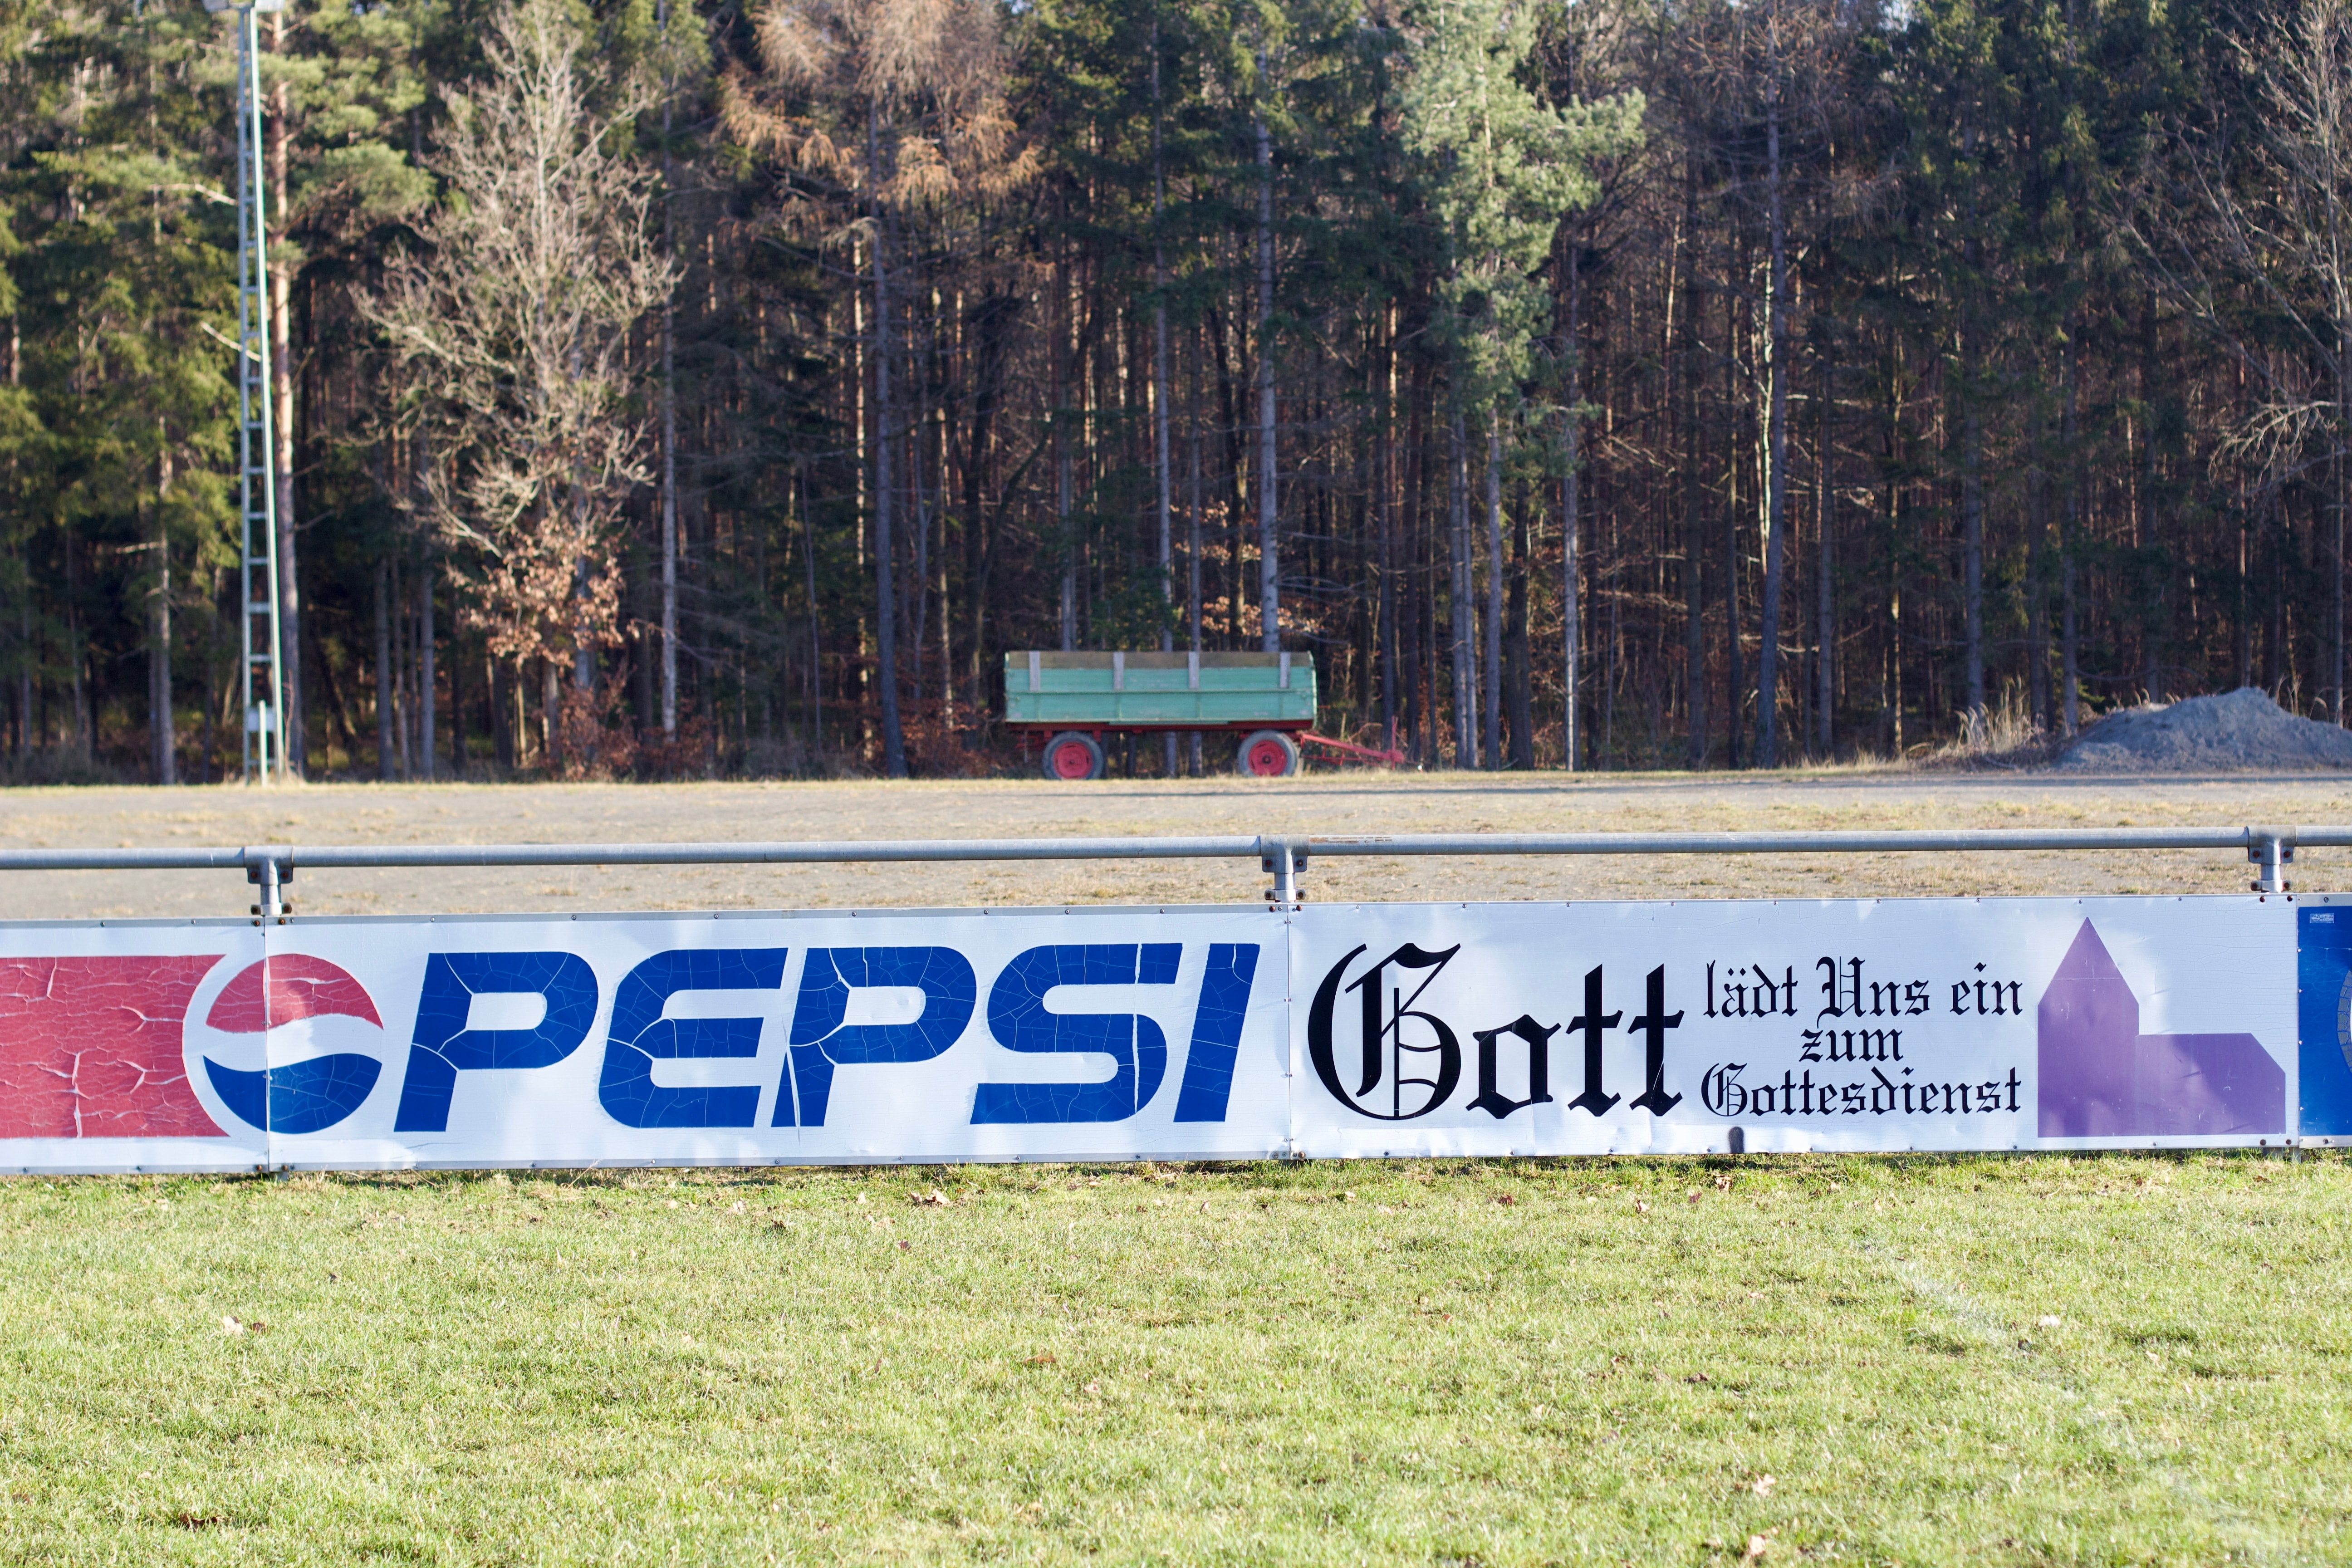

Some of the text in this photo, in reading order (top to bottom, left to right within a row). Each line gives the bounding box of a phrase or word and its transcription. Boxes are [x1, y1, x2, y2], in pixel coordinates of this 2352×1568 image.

[1703, 956, 2023, 1029] lädt Uns ein
[393, 943, 1261, 1132] PEPSI
[1308, 943, 1685, 1121] Gott
[1799, 1029, 1903, 1063] zum
[1701, 1063, 2021, 1117] Gottesdienst
